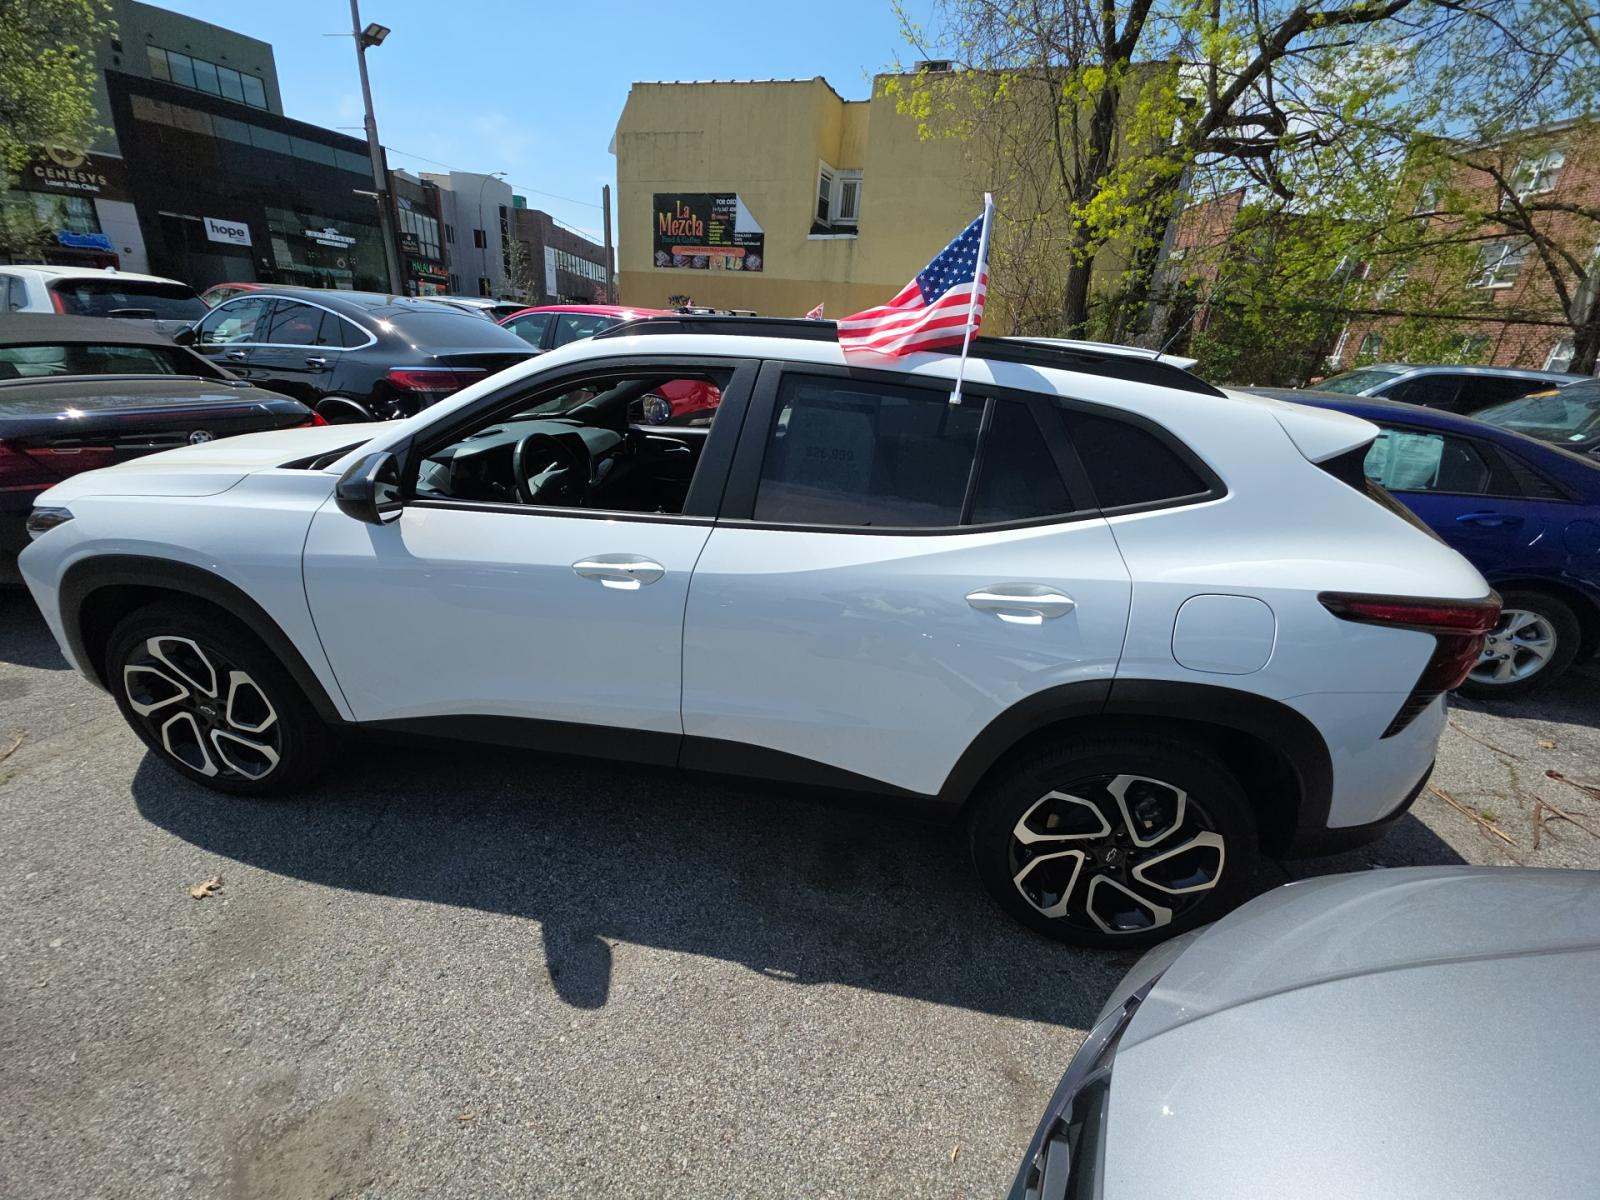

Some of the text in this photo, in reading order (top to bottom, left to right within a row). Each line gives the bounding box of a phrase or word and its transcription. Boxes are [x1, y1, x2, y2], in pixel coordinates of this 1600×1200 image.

[676, 200, 690, 219] La
[210, 219, 245, 239] hope
[659, 212, 704, 236] Mezcla
